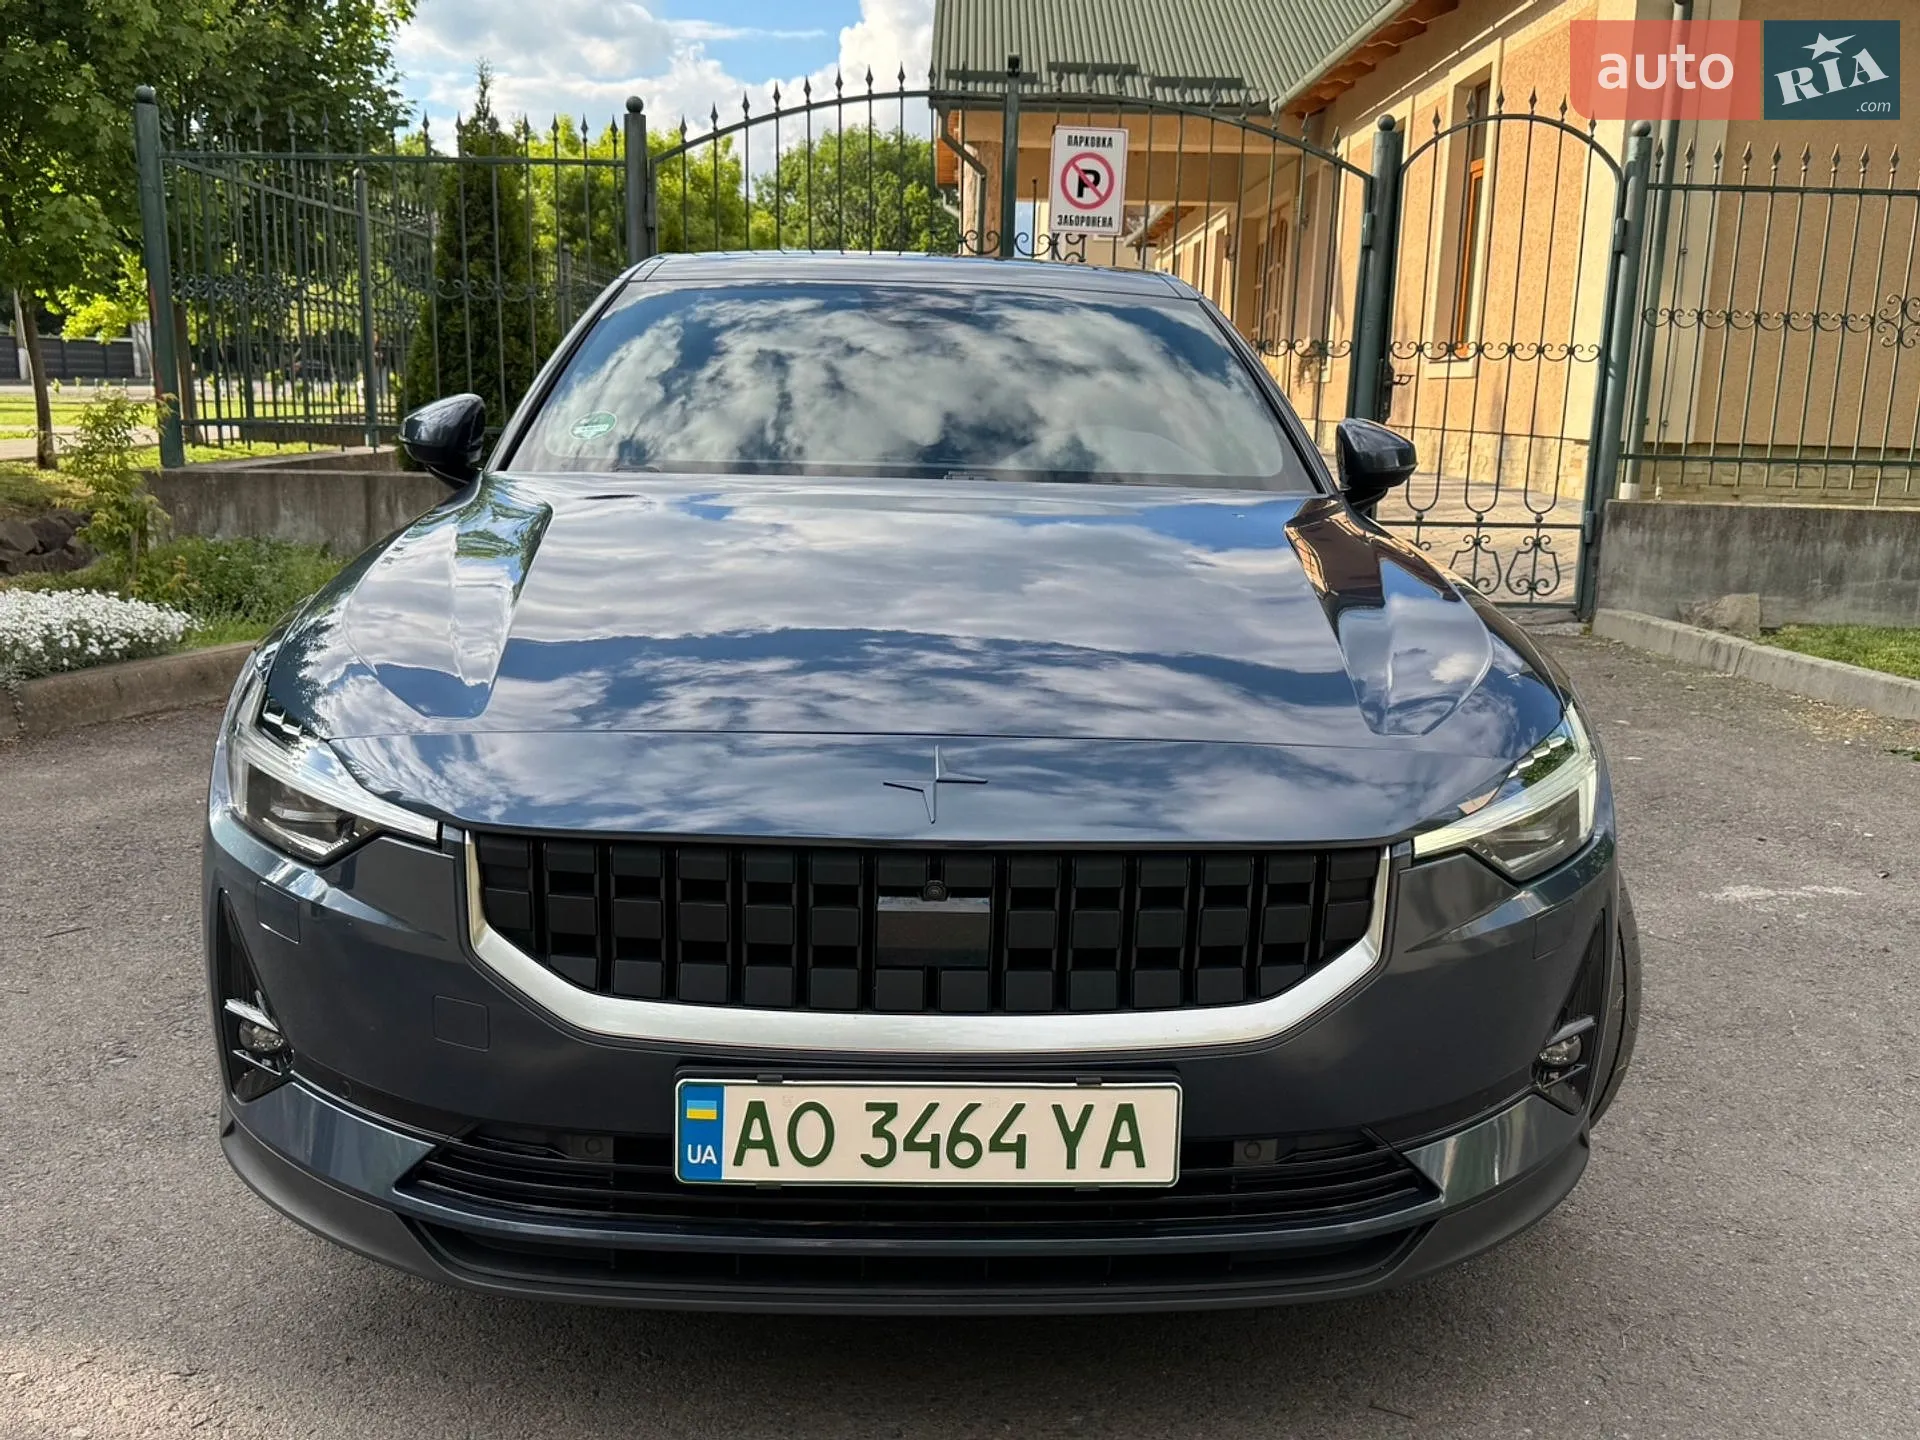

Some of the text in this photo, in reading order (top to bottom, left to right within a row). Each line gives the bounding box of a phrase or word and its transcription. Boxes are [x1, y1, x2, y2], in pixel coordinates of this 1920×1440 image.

[1067, 135, 1113, 148] ПАРКОВКА
[1077, 169, 1100, 198] P
[1057, 214, 1113, 228] ЗАБОРОНЕНА
[733, 1101, 1146, 1169] AO 3464 YA
[687, 1145, 717, 1165] UA
